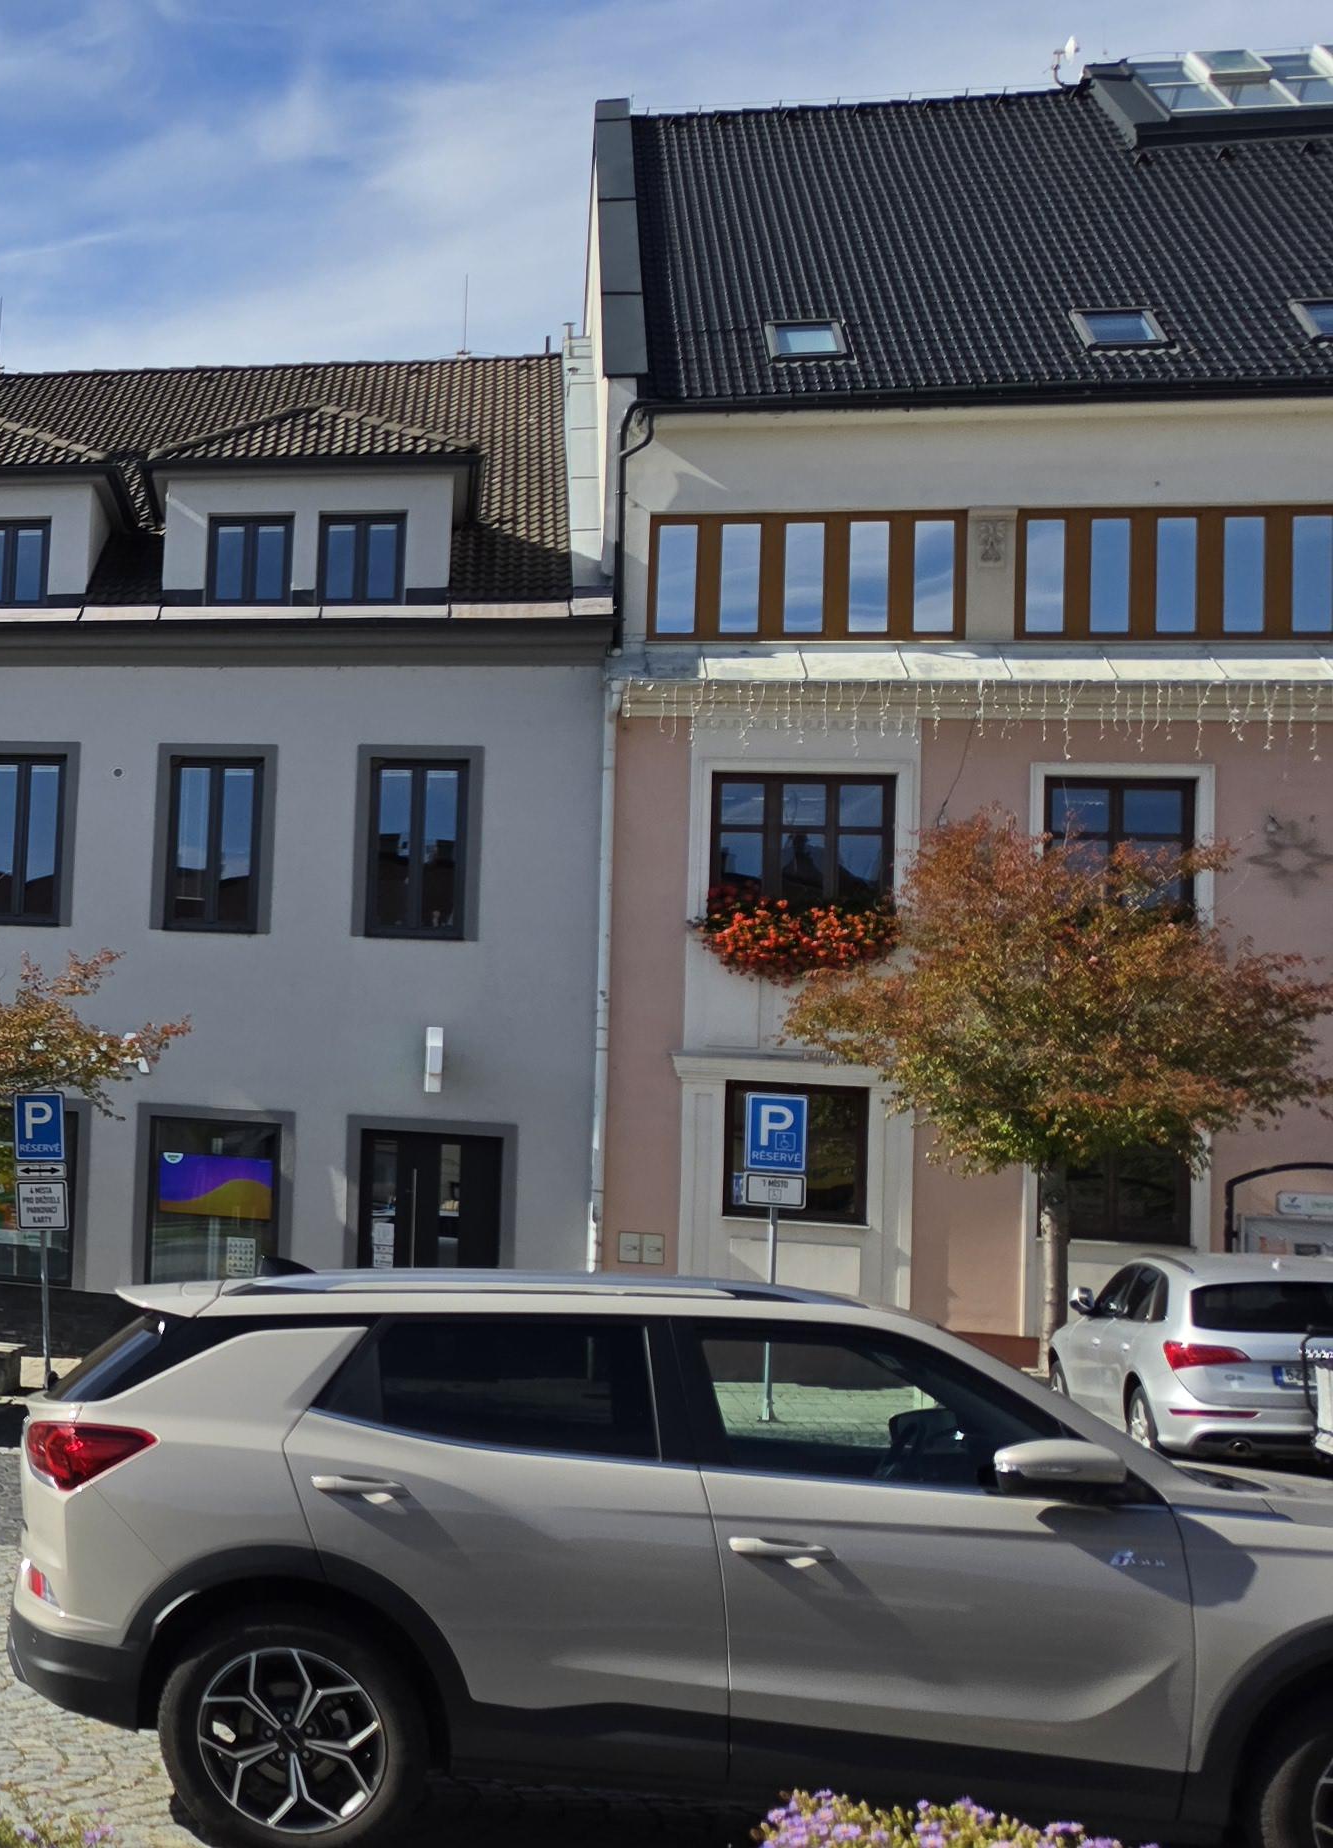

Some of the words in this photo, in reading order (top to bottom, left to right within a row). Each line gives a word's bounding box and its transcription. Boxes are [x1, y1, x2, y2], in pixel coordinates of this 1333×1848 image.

[24, 1101, 54, 1139] P
[760, 1104, 794, 1146] P
[19, 1142, 62, 1153] RÉSERVÉ
[752, 1150, 802, 1163] RÉSERVÉ
